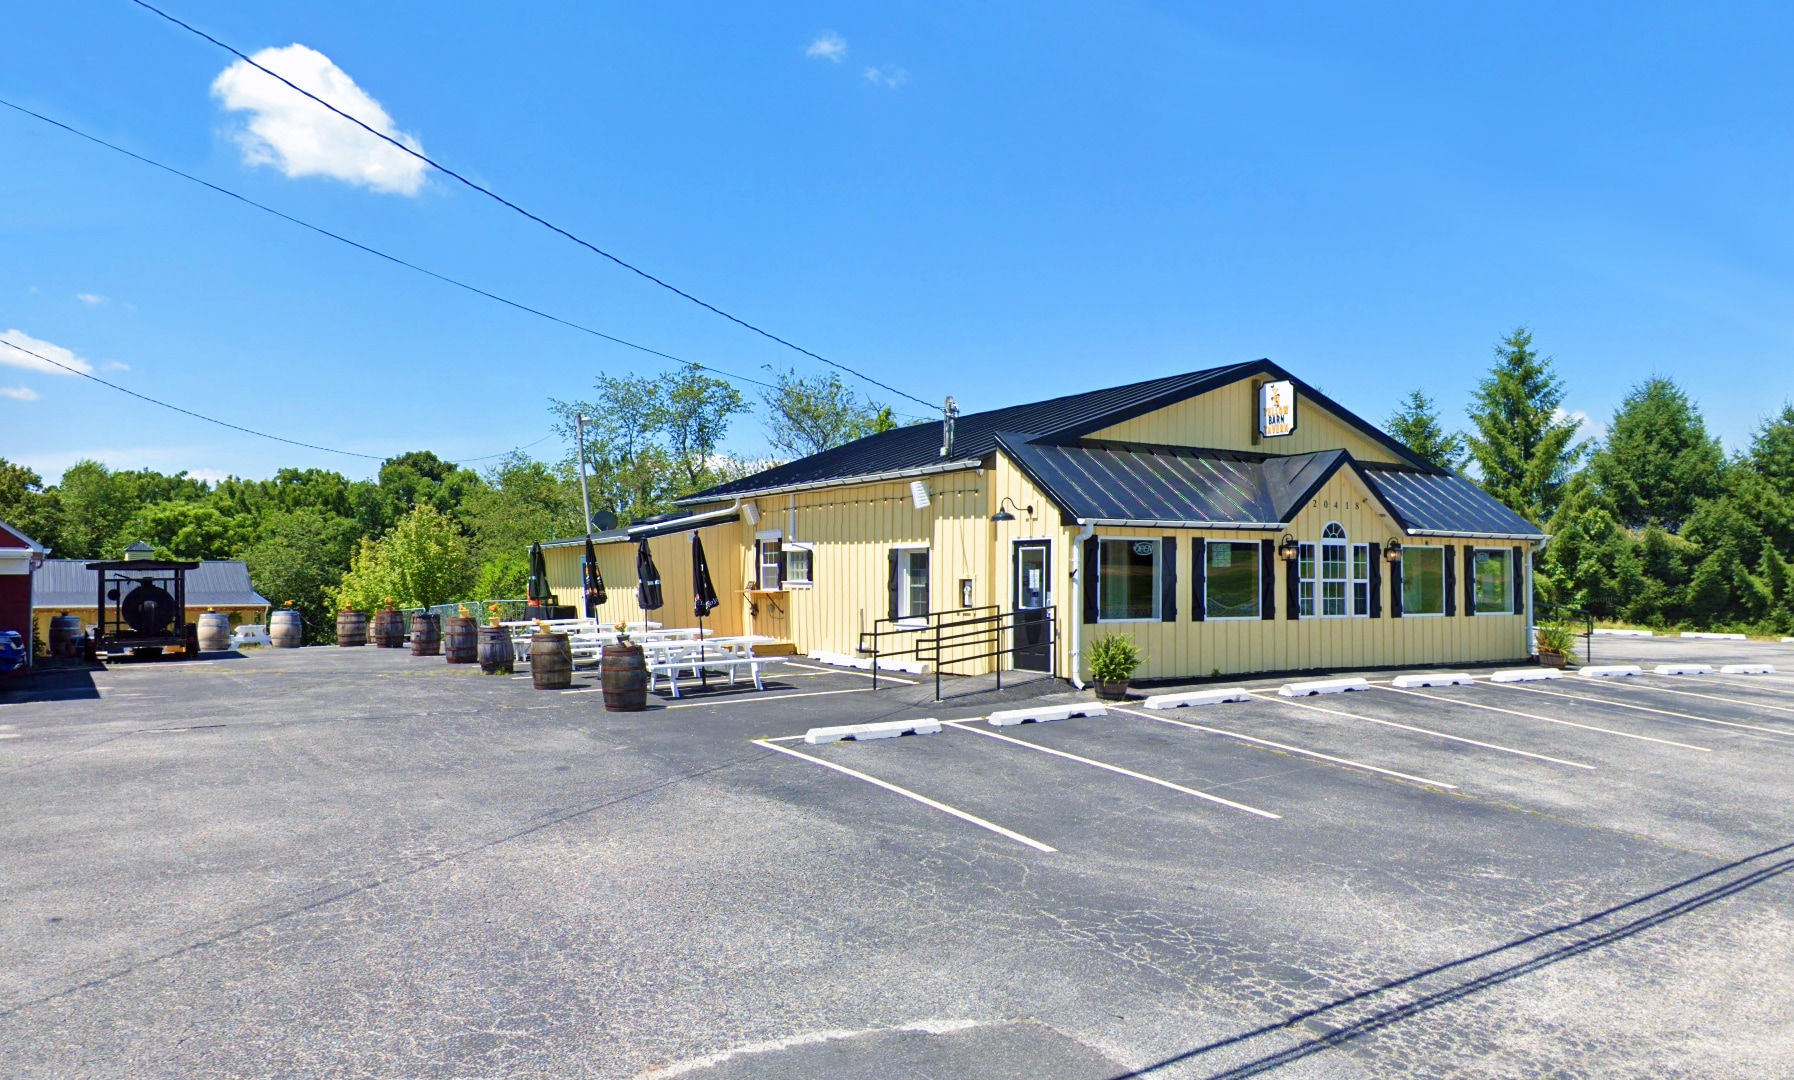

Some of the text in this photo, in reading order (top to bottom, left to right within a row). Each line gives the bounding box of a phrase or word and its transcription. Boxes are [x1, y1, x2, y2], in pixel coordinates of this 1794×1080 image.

[1263, 405, 1289, 417] YELLOW
[1268, 415, 1285, 425] BARN
[1263, 424, 1289, 435] TAVERN
[1312, 499, 1360, 510] 20418
